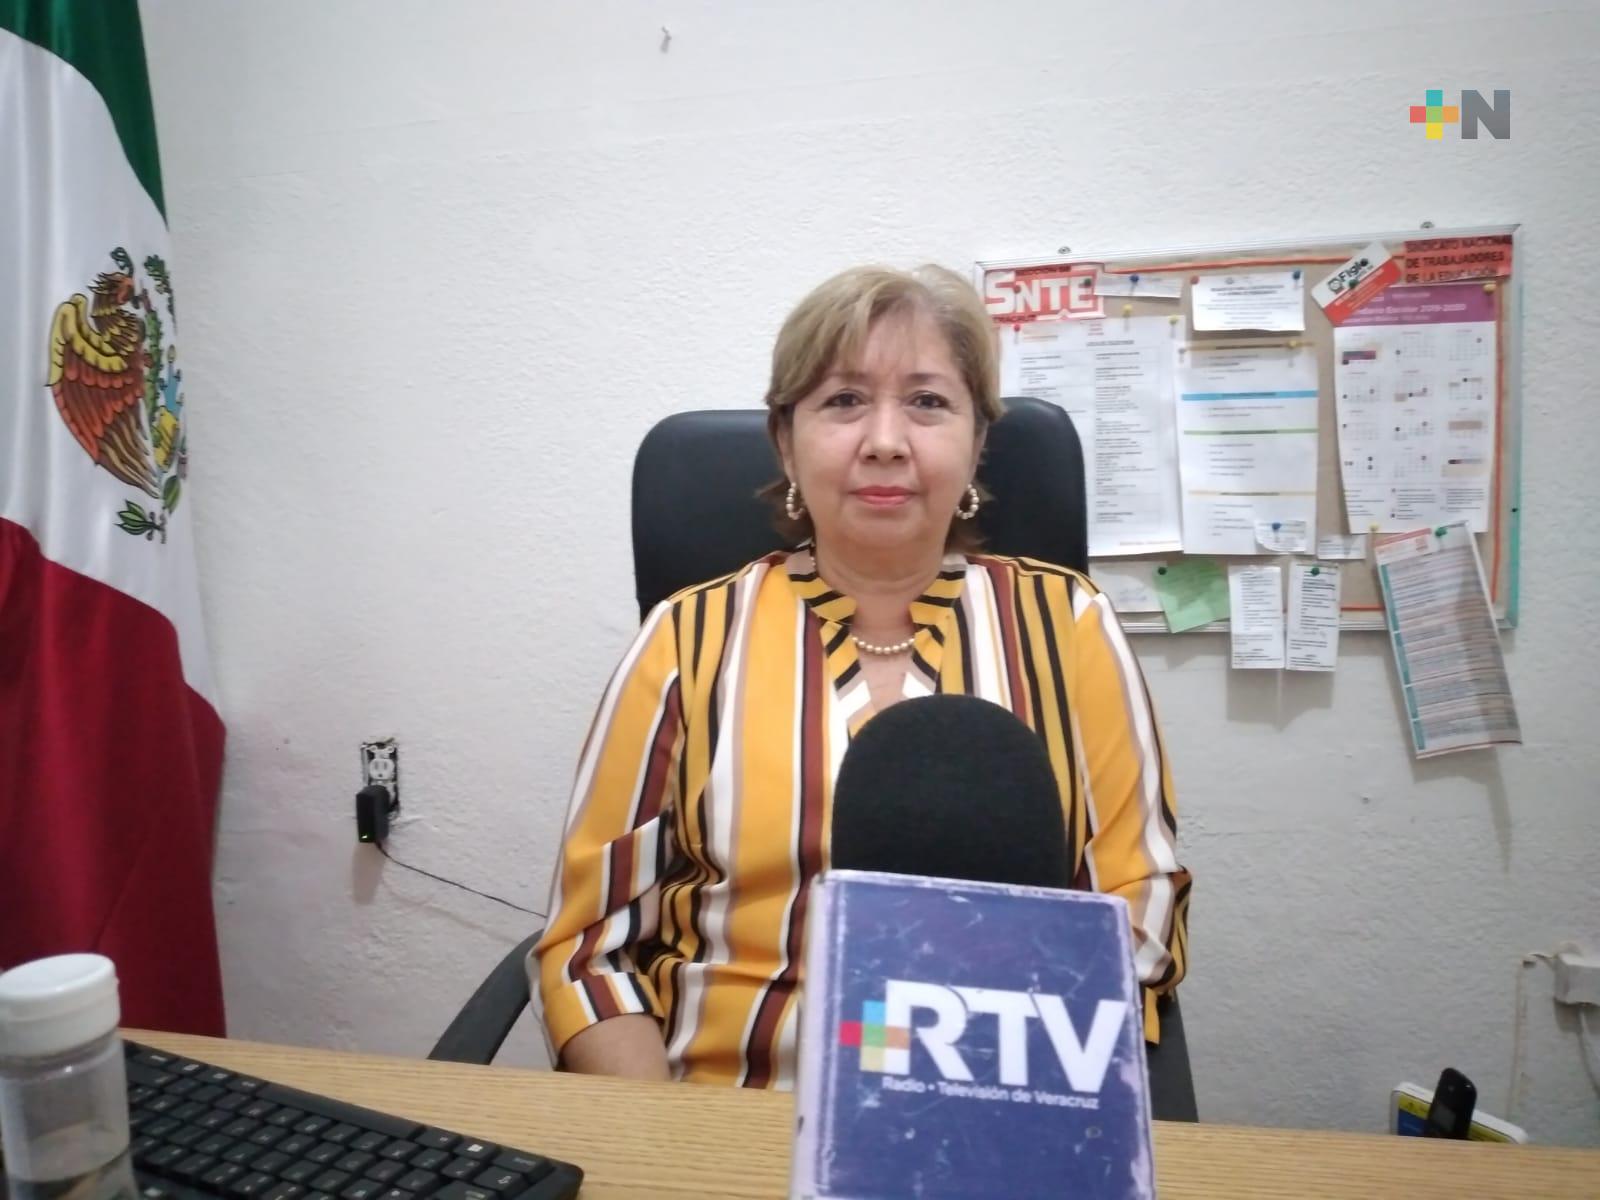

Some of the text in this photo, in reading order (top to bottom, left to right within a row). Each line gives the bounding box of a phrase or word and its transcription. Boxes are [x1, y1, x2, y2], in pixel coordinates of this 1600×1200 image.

[1423, 251, 1505, 266] TRABAJADORES
[984, 270, 1094, 316] SNTE
[886, 979, 1128, 1093] RTV
[882, 1075, 1099, 1110] Radio Televisión de Veracruz
